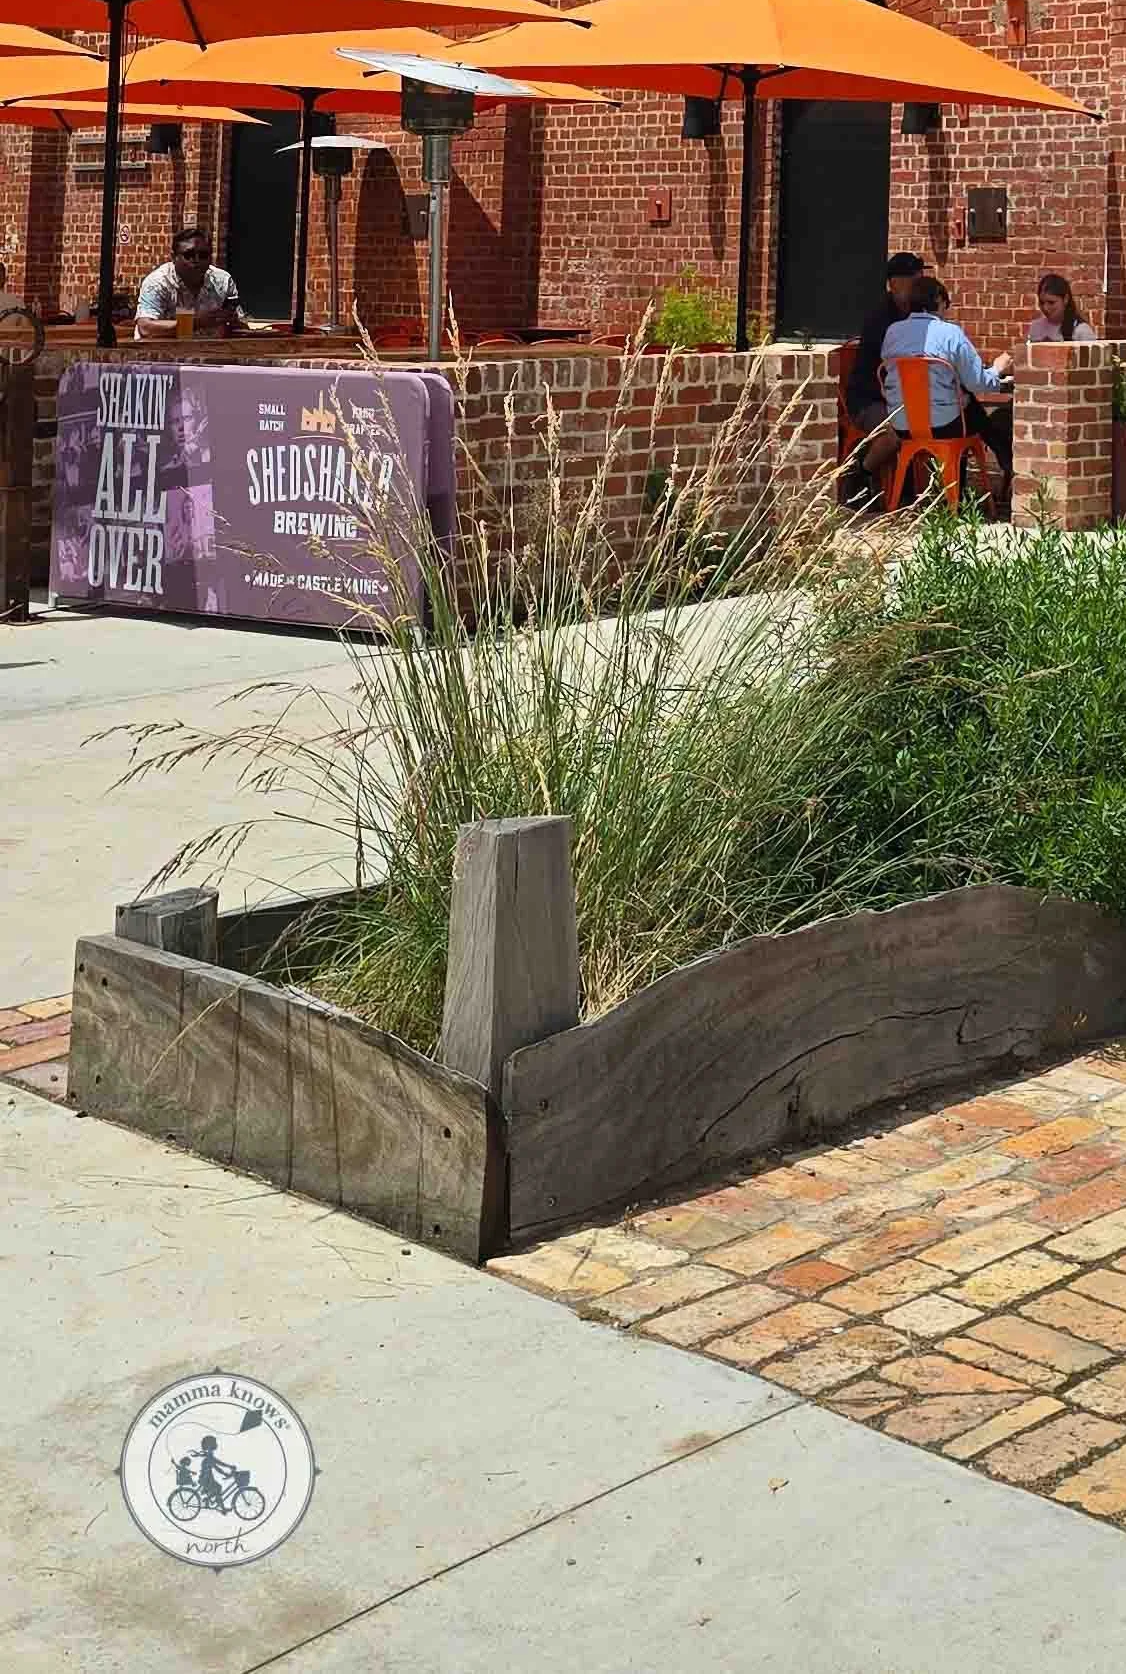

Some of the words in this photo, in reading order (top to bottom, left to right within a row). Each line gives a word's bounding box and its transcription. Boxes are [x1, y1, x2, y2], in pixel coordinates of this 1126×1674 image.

[96, 373, 174, 431] SHAKIN'
[258, 403, 287, 416] SMALL
[259, 419, 285, 432] BATCH
[91, 432, 168, 524] ALL
[273, 509, 358, 538] BREWING
[87, 524, 164, 595] OVER
[252, 571, 285, 589] MADE
